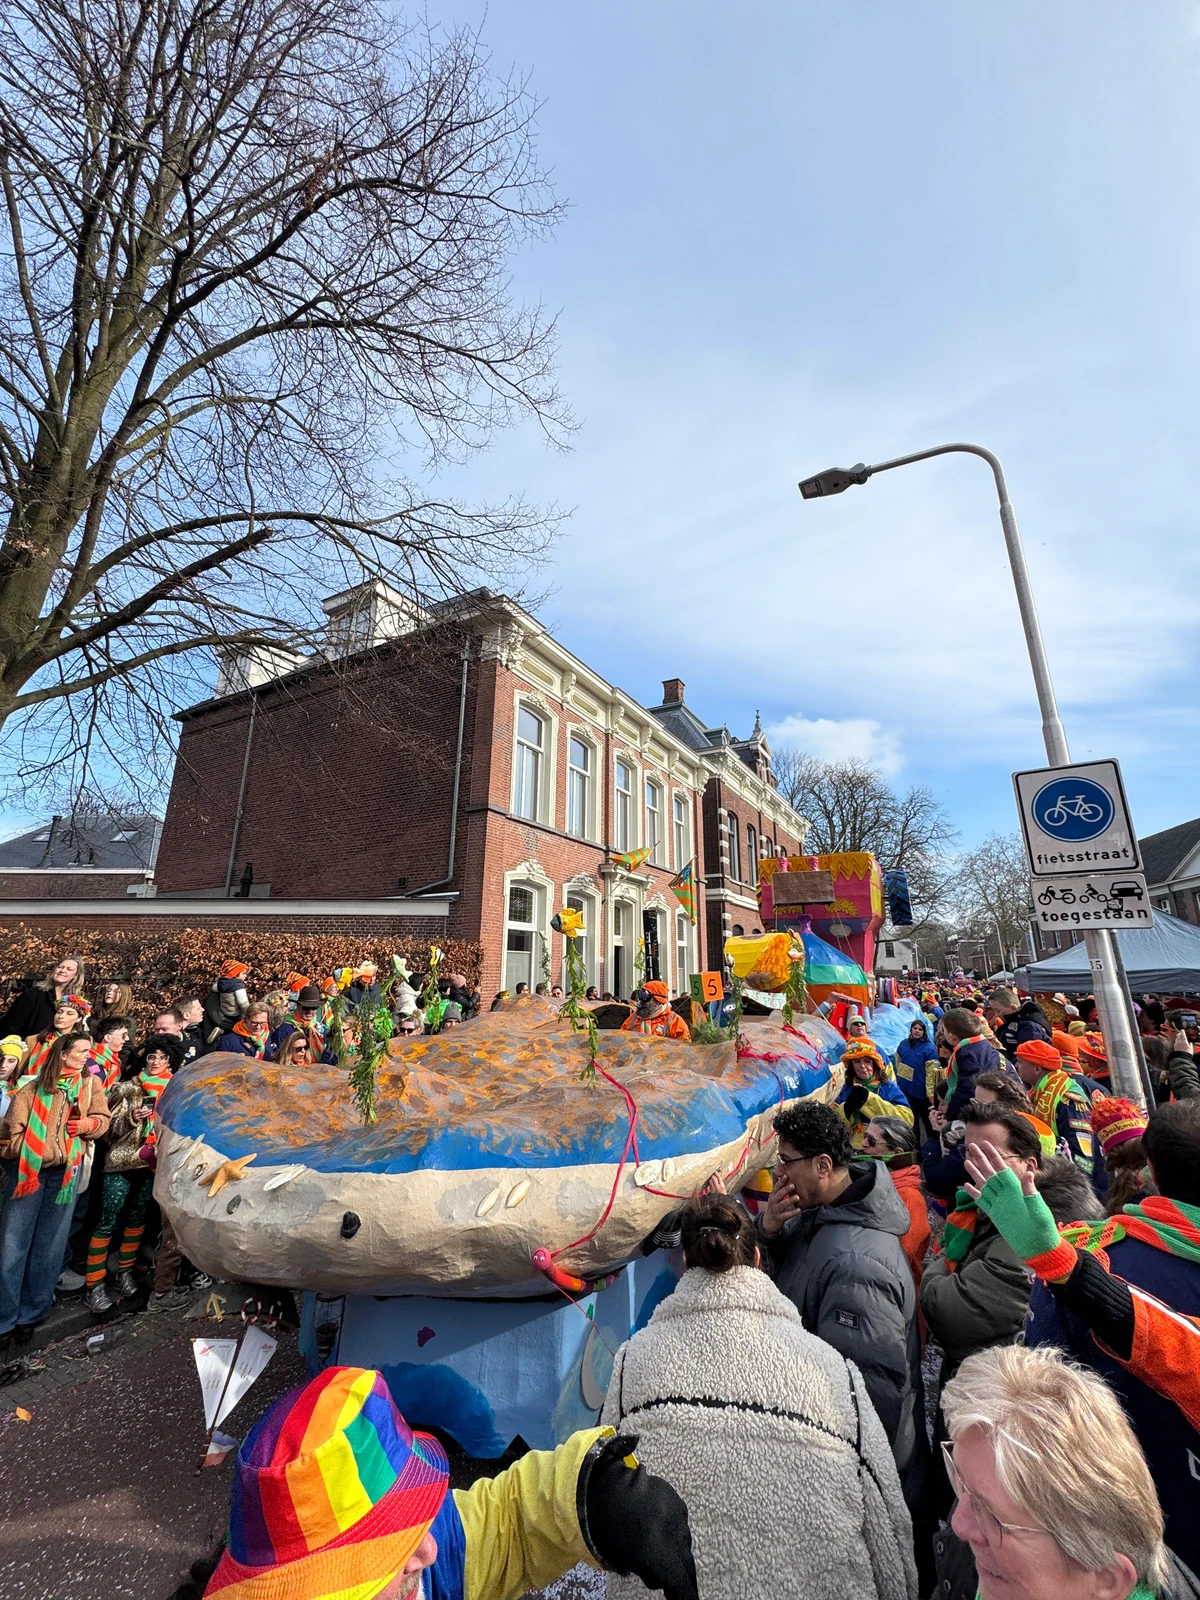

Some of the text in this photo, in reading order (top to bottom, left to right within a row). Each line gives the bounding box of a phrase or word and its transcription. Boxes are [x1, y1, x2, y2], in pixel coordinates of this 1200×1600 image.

[1036, 848, 1129, 865] fietsstraat
[1041, 908, 1148, 924] toegestaan
[693, 980, 700, 996] 5
[707, 978, 718, 997] 5
